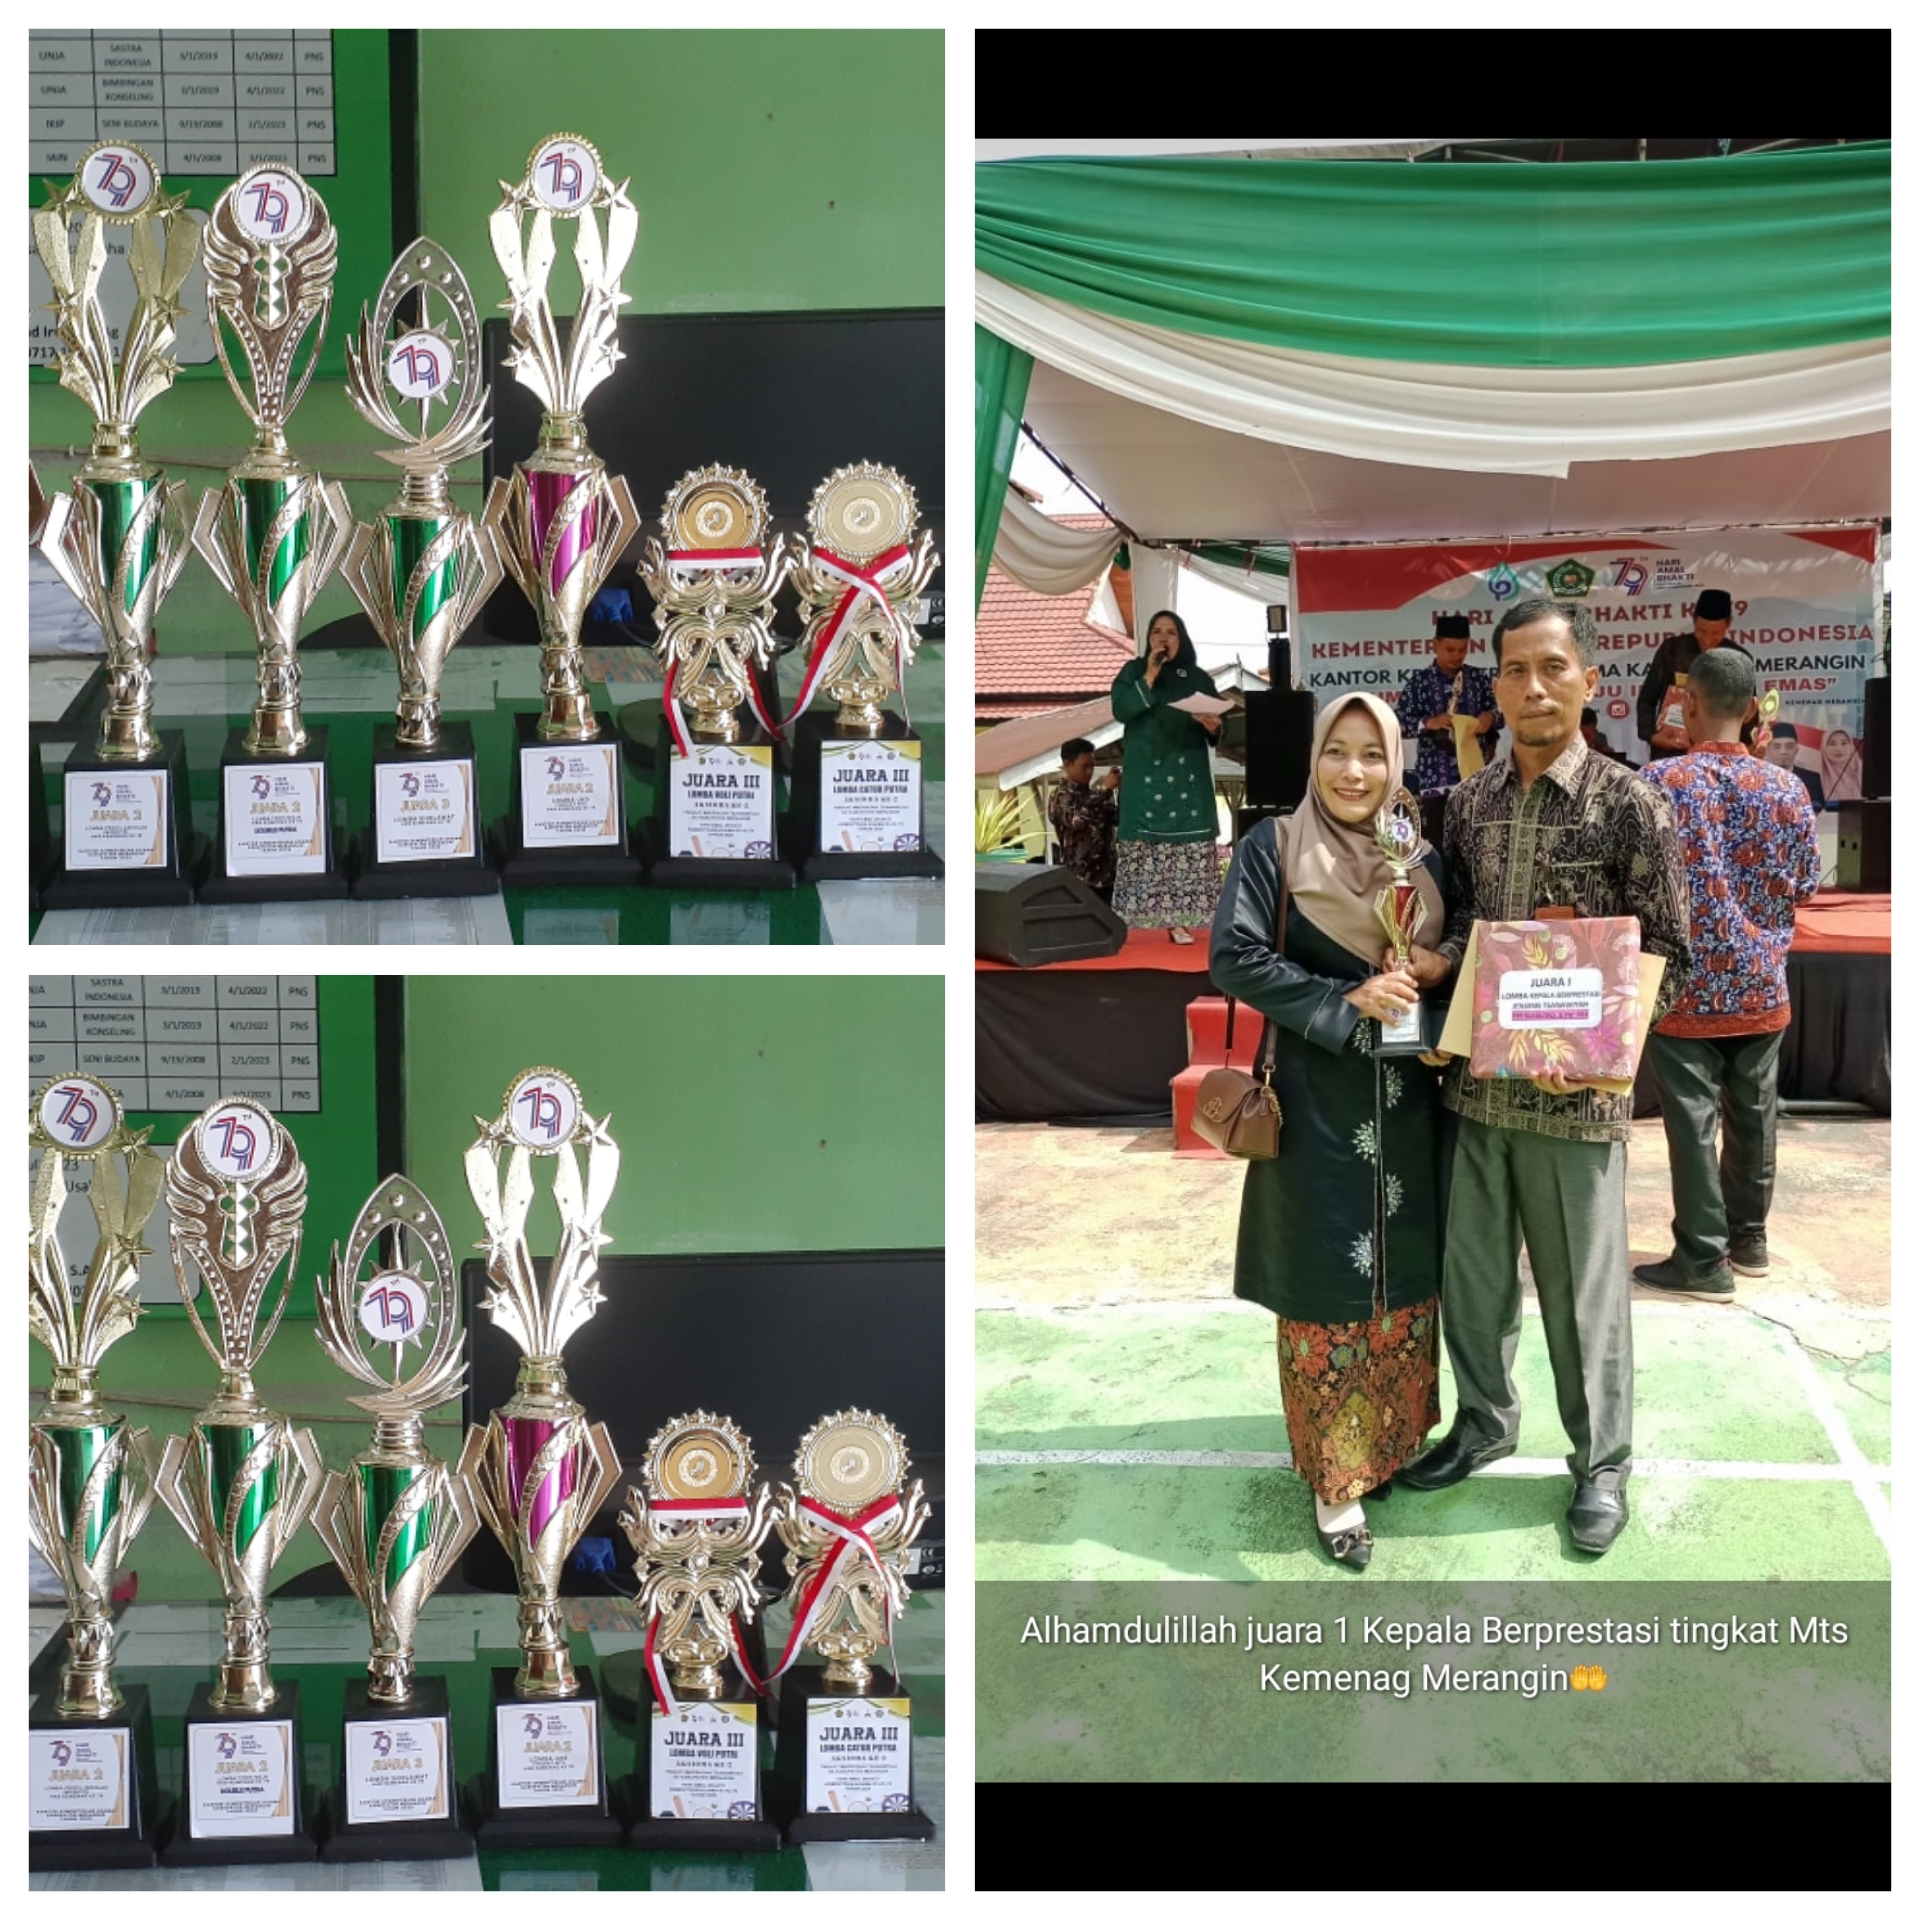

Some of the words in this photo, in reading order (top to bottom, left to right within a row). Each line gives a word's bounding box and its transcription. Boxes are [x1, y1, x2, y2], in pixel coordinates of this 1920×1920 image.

[304, 52, 324, 62] PNS
[104, 59, 151, 67] INDONESIA
[305, 86, 324, 96] PNS
[306, 120, 326, 130] PNS
[307, 153, 326, 164] PNS
[539, 151, 582, 201] 79
[245, 182, 289, 235] 79
[393, 344, 440, 391] 79
[1656, 558, 1681, 567] HARI
[1609, 557, 1649, 597] 79
[1656, 574, 1695, 582] BHAKTI
[1587, 603, 1673, 622] HAKTI
[1312, 637, 1486, 660] KEMENTERN
[1729, 624, 1874, 645] INDONESIA
[1309, 669, 1391, 688] KANTOR
[1755, 654, 1866, 673] MERANGIN
[833, 768, 888, 783] JUARA
[892, 768, 910, 783] III
[682, 773, 739, 788] JUARA
[744, 775, 760, 789] III
[688, 790, 713, 799] LOMBA
[833, 785, 858, 794] LOMBA
[90, 978, 124, 987] SASTRA
[1530, 977, 1566, 988] JUARA
[1567, 976, 1572, 987] I
[288, 987, 308, 997] PNS
[1501, 991, 1528, 1000] LOMBA
[85, 993, 133, 1002] INDONESIA
[83, 1013, 134, 1023] BIMBINGAN
[289, 1021, 309, 1031] PNS
[86, 1028, 136, 1037] KONSELING
[290, 1056, 310, 1066] PNS
[291, 1090, 312, 1100] PNS
[518, 1087, 562, 1138] 79
[210, 1116, 256, 1171] 79
[364, 1286, 414, 1334] 79
[664, 1731, 722, 1747] JUARA
[727, 1733, 745, 1747] III
[820, 1727, 876, 1741] JUARA
[881, 1727, 899, 1740] III
[669, 1748, 695, 1757] LOMBA
[820, 1744, 846, 1752] LOMBA
